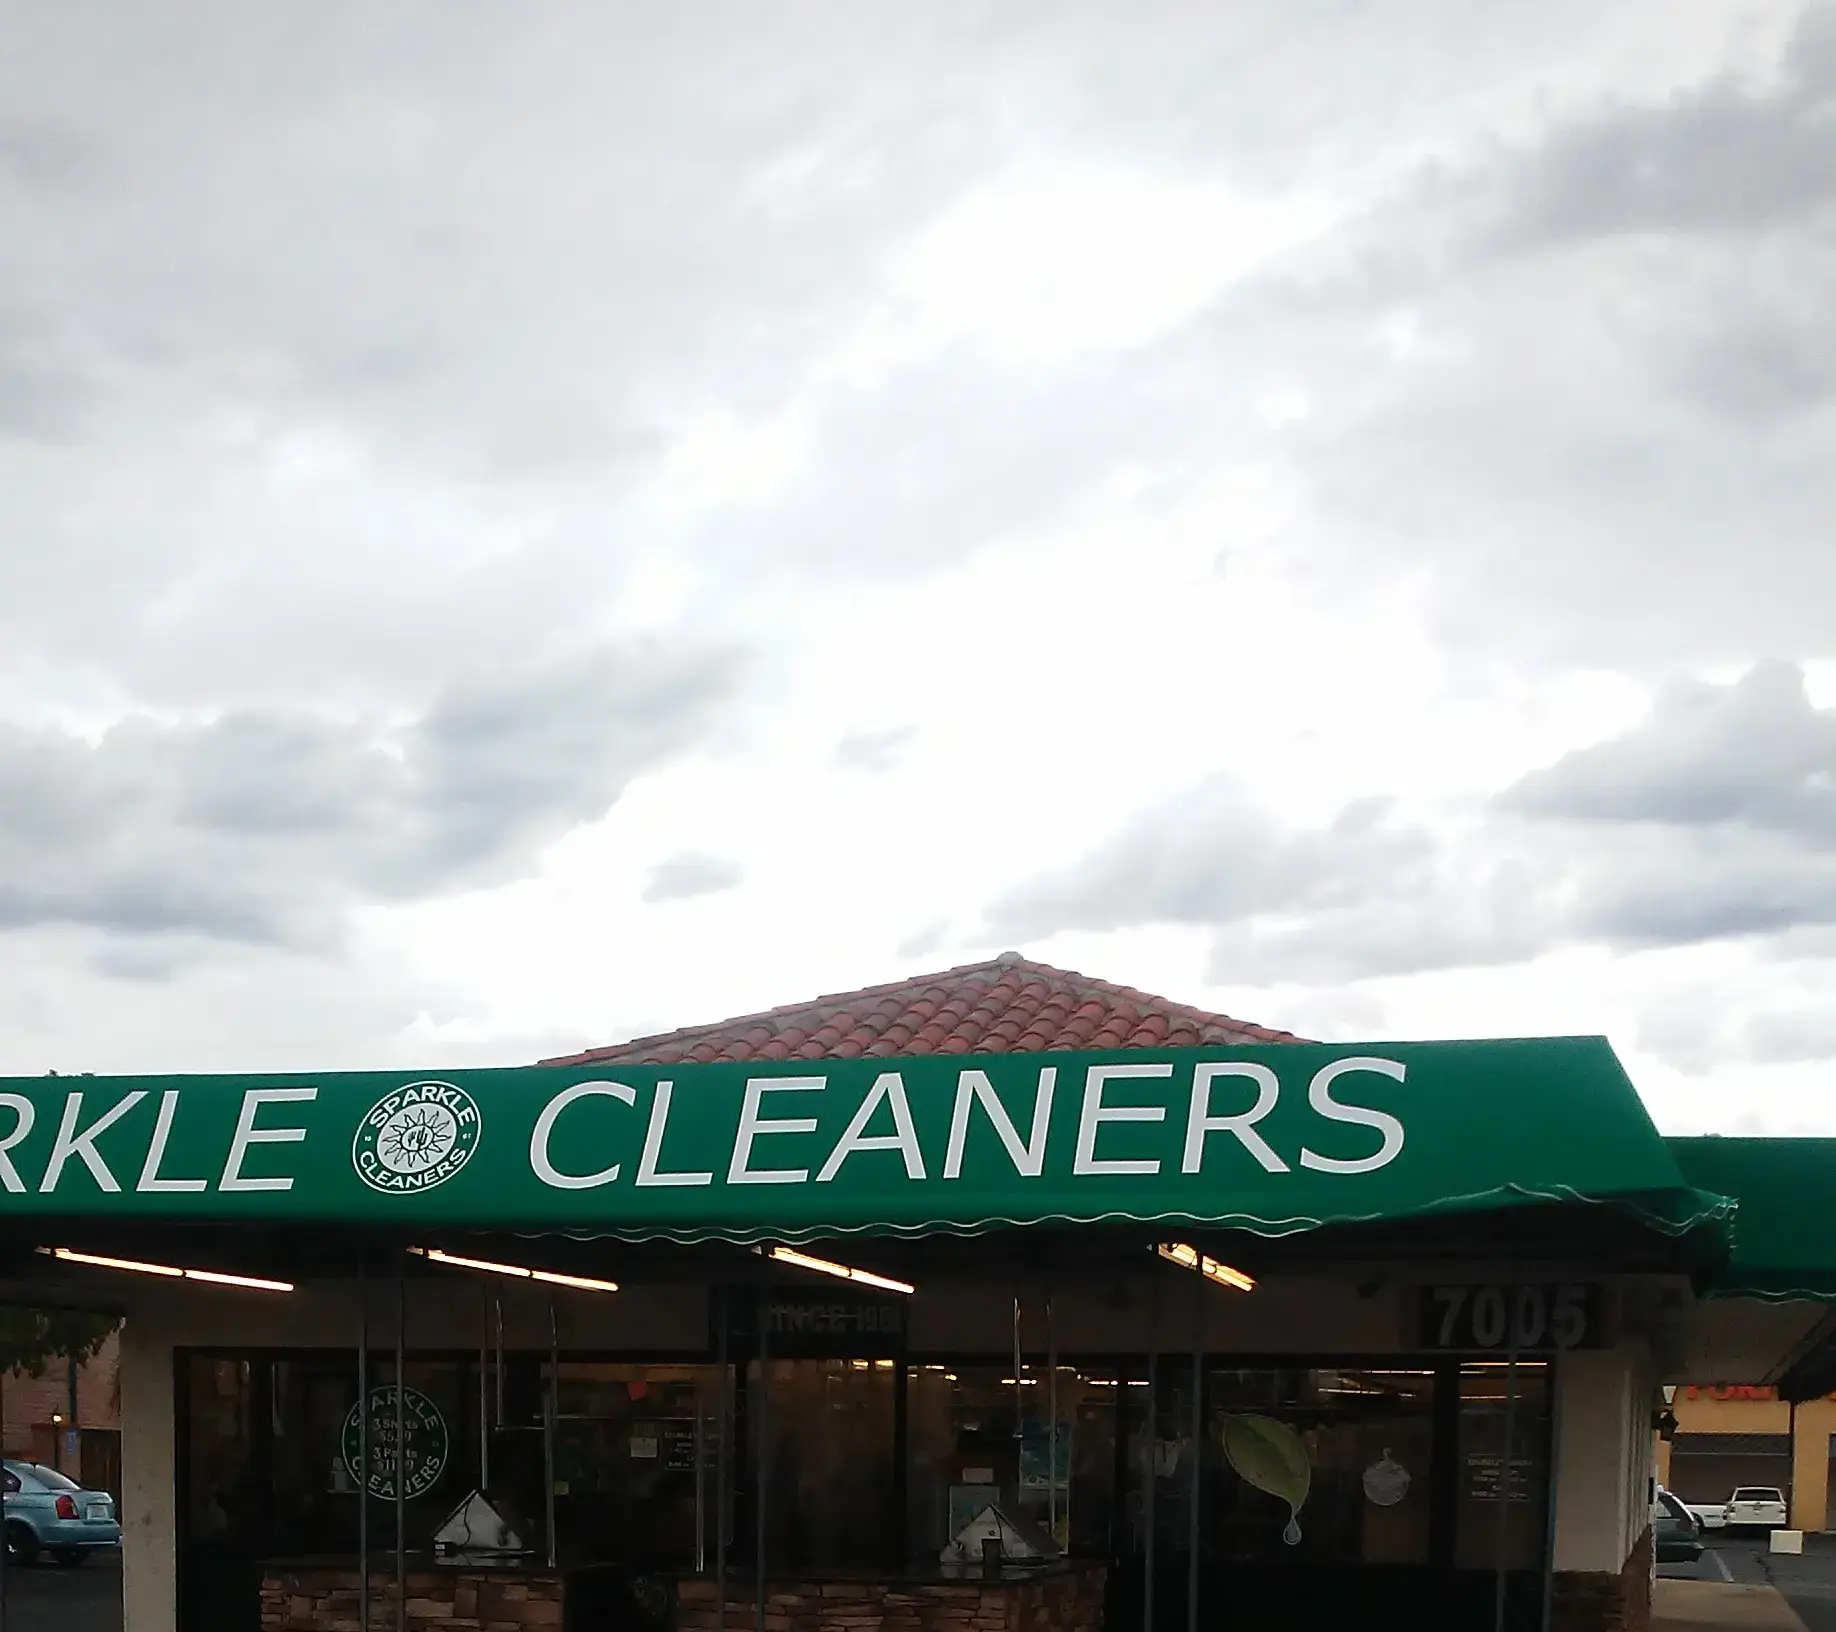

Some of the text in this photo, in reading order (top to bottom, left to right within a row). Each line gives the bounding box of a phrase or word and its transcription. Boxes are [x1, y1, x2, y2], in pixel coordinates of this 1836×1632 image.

[369, 1085, 475, 1129] SPARKLE
[528, 1056, 1408, 1189] CLEANERS
[360, 1148, 467, 1189] CLEANERS
[1433, 1286, 1588, 1348] 7005
[351, 1390, 439, 1431] SARKLE
[352, 1456, 440, 1496] CEANERS
